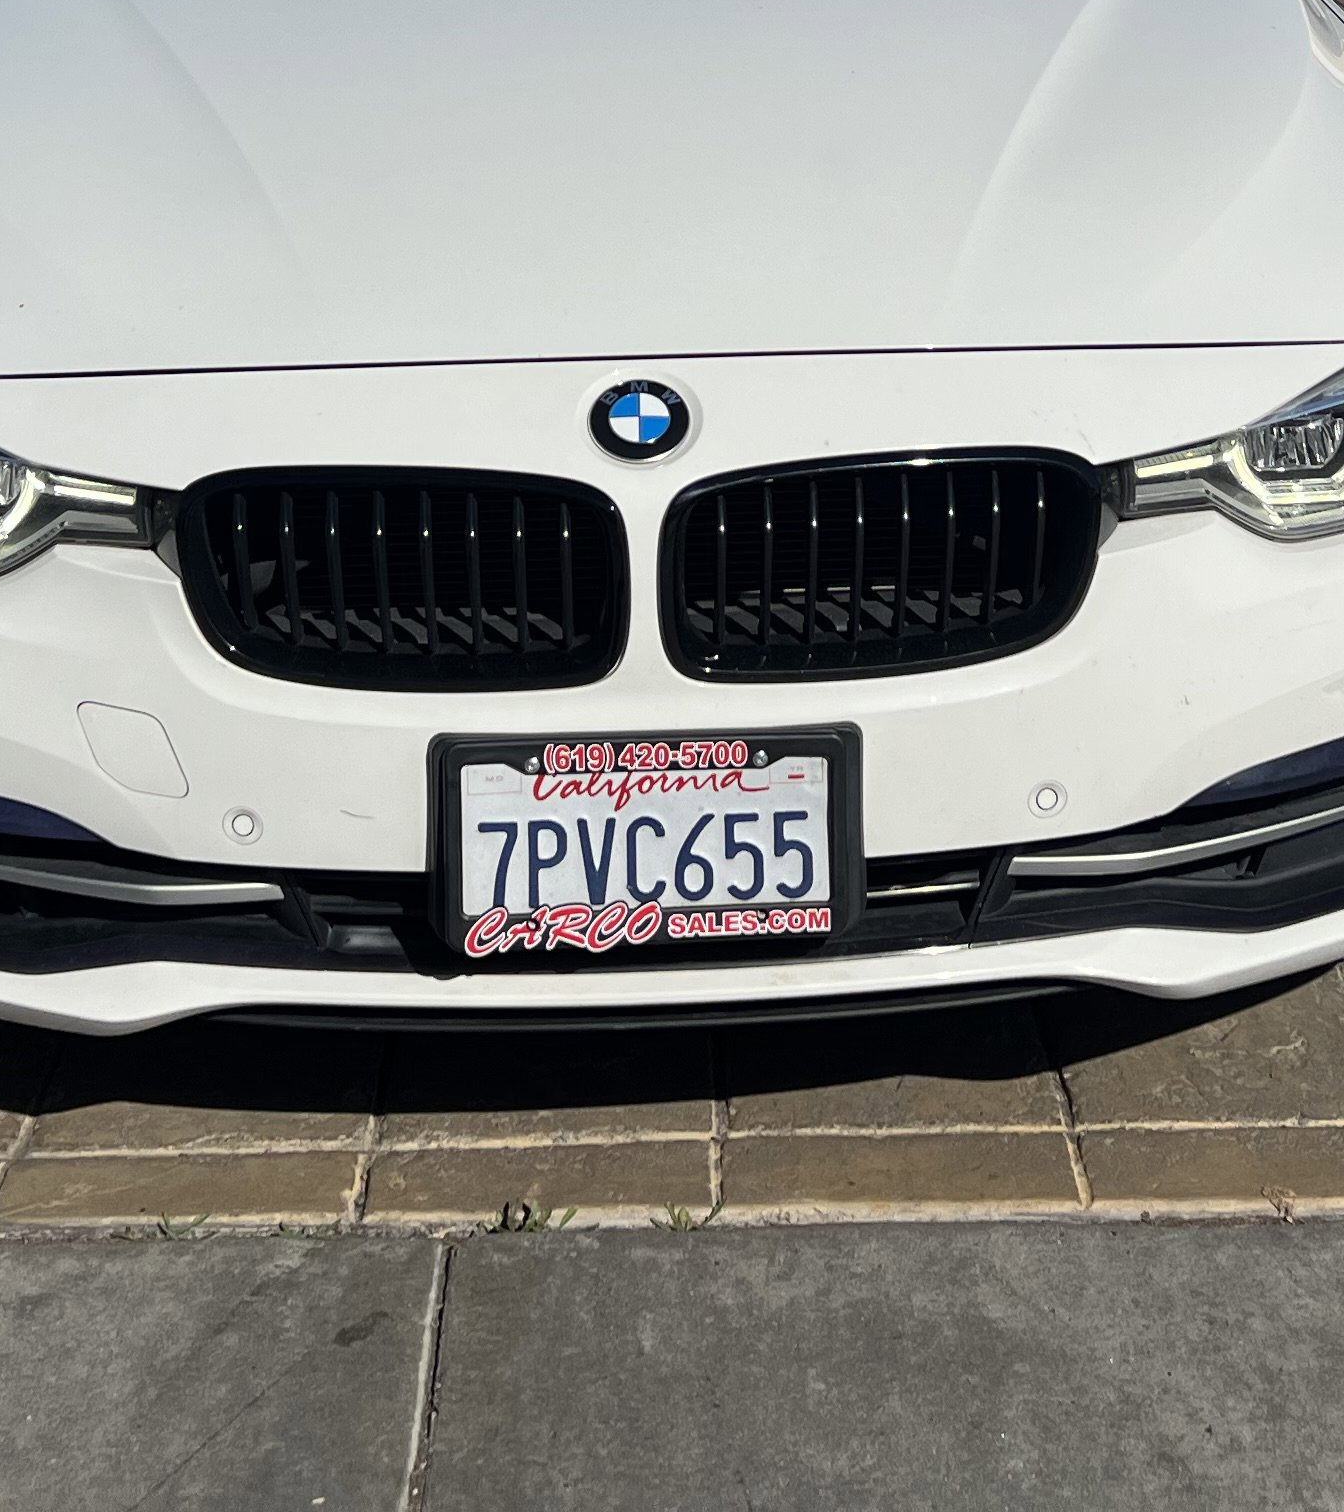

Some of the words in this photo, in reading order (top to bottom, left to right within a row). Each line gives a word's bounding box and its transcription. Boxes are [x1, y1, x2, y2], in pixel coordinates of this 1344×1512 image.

[599, 381, 682, 406] BMW
[543, 742, 616, 774] (619)
[618, 740, 748, 772] 420-5700
[531, 770, 770, 812] California
[477, 810, 814, 909] 7PVC655
[464, 900, 663, 958] CARCO
[667, 908, 831, 938] SALES.COM
